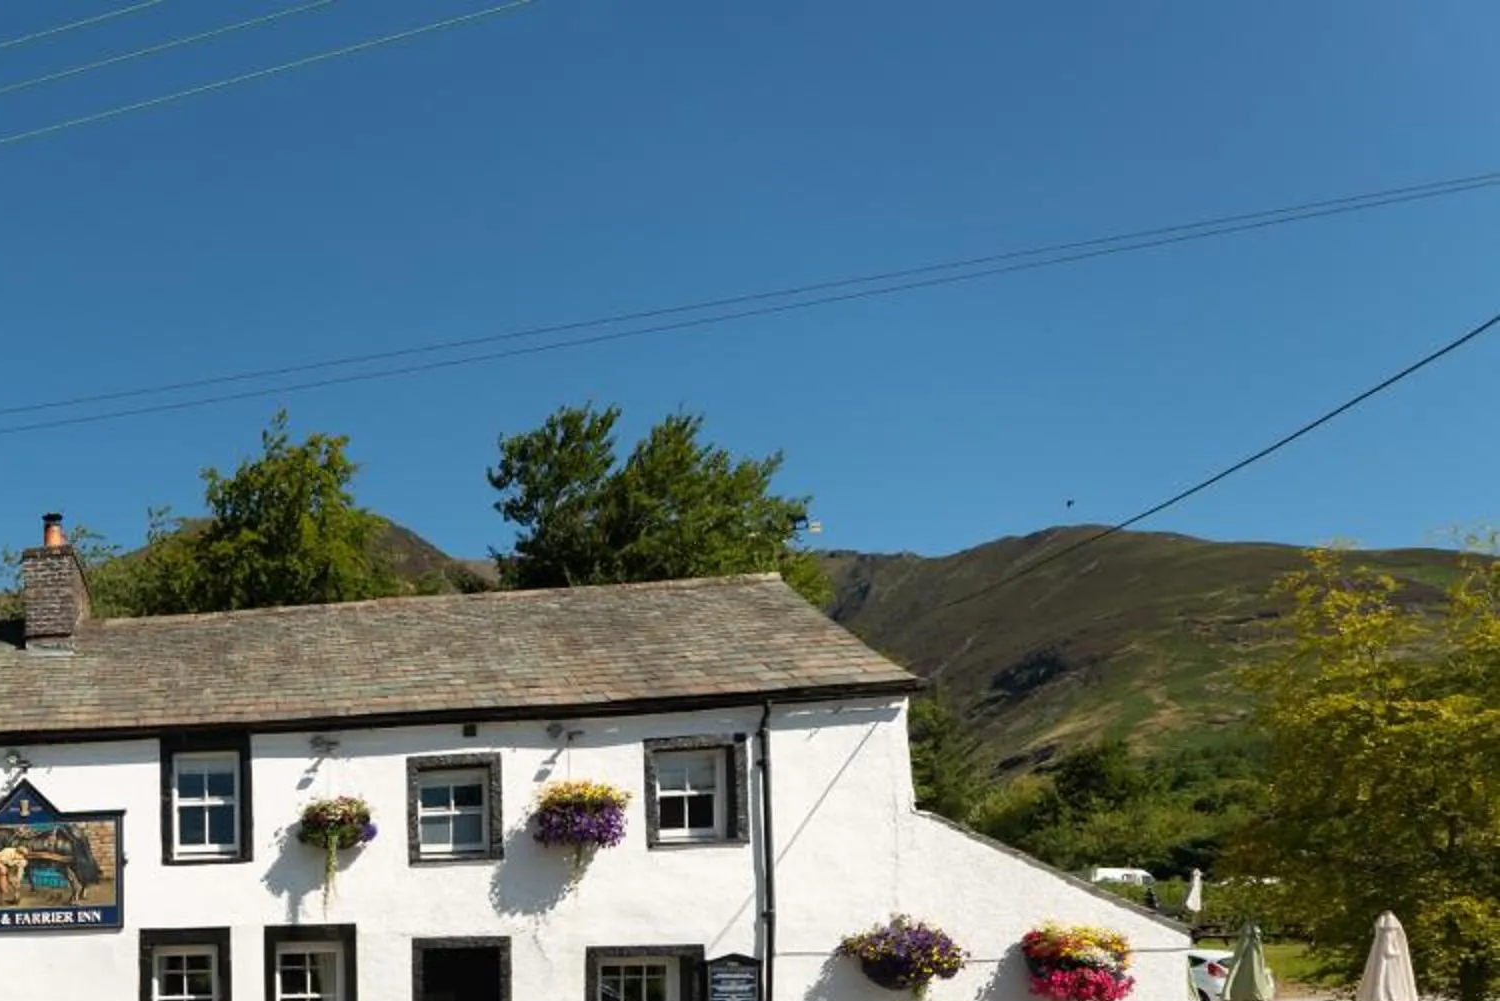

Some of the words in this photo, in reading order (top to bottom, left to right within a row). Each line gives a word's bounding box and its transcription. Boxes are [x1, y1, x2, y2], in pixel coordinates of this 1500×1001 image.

[0, 912, 11, 925] &
[15, 911, 74, 925] FARRIER
[77, 910, 102, 923] INN
